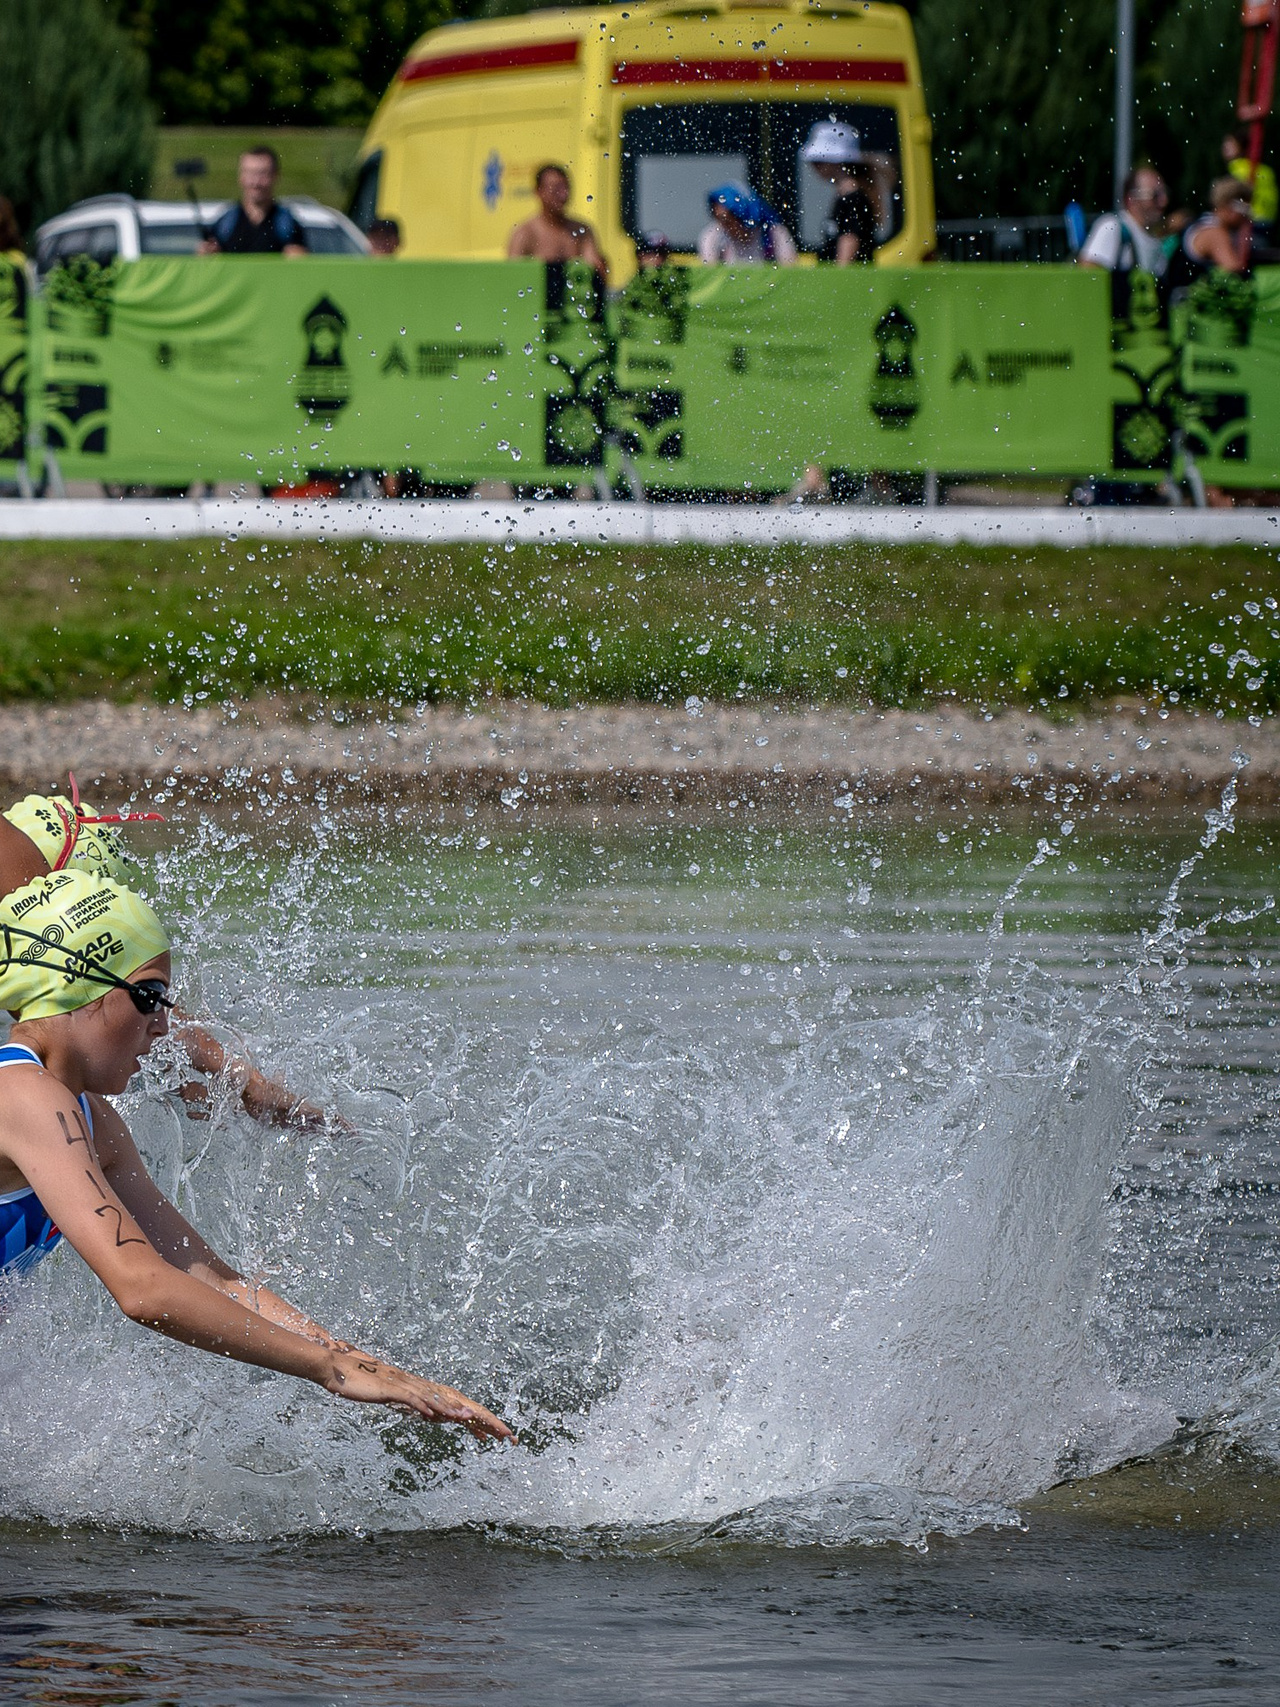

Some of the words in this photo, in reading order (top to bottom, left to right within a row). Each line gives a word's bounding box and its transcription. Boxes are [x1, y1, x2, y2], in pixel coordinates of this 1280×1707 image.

[11, 894, 38, 916] IRON
[65, 887, 113, 915] ФЕДЕРАЦИЯ
[70, 893, 119, 922] ТРИАТЛОНА
[75, 905, 111, 929] РОССИИ
[63, 939, 124, 984] WAVE
[65, 931, 113, 971] MAD
